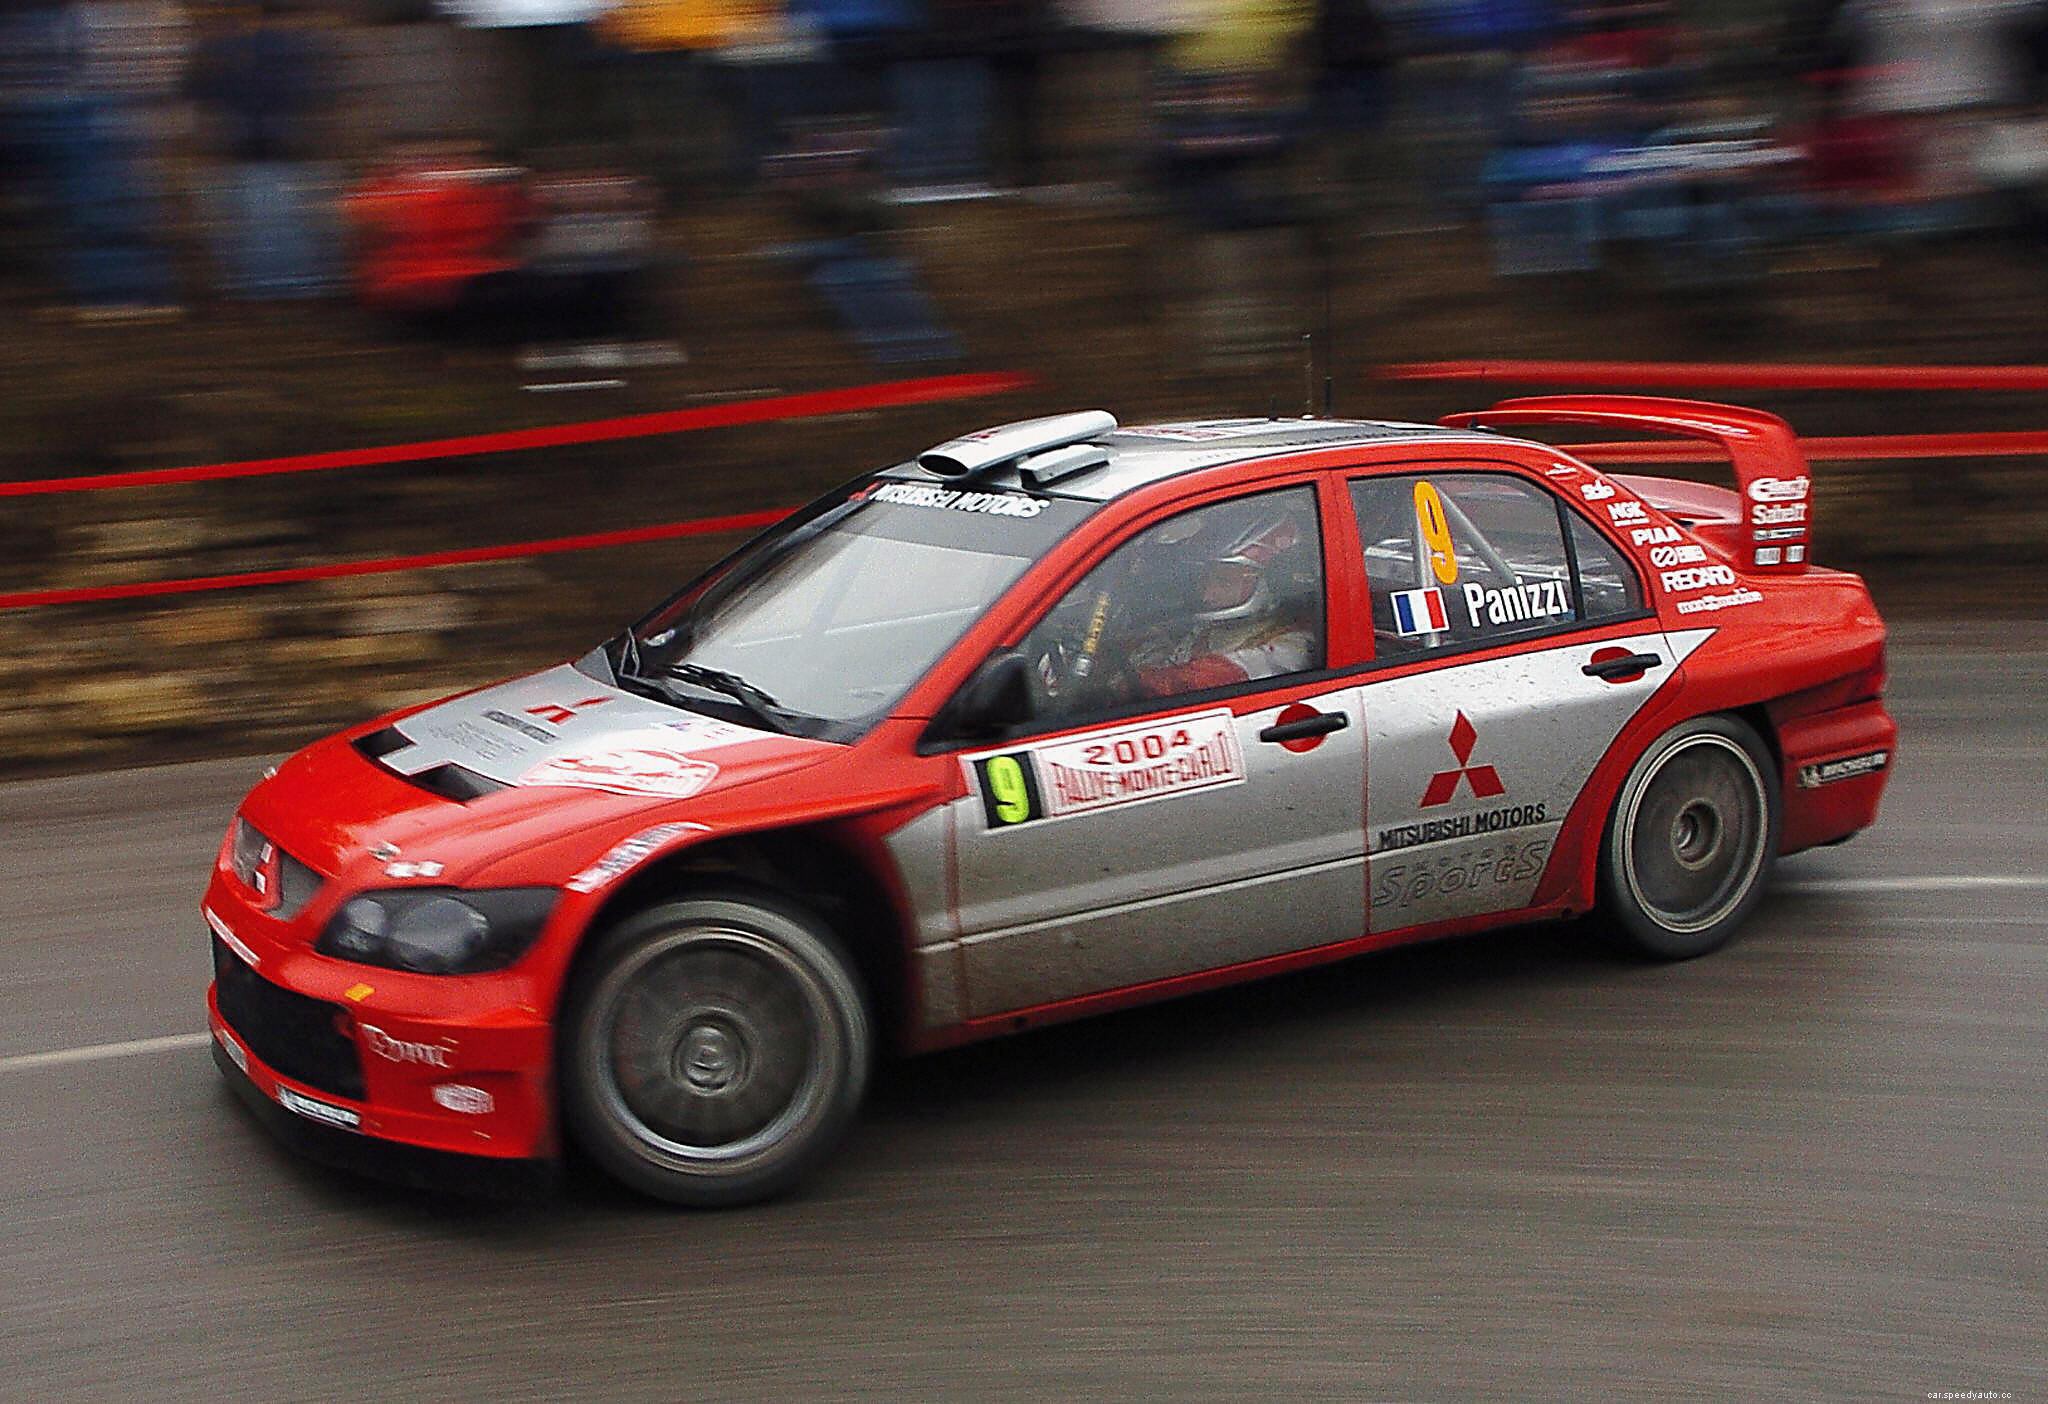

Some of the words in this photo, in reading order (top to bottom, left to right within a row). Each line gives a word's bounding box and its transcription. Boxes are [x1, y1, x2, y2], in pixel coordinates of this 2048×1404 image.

[1606, 501, 1647, 520] NGK
[1413, 479, 1459, 585] 9
[1631, 526, 1683, 546] PIAA
[1462, 570, 1569, 628] Panizzi
[1660, 564, 1736, 593] RECARO
[1084, 729, 1191, 766] 2004
[985, 756, 1030, 824] 9
[1378, 816, 1470, 850] MITSUBISHI
[1474, 803, 1546, 833] MOTORS
